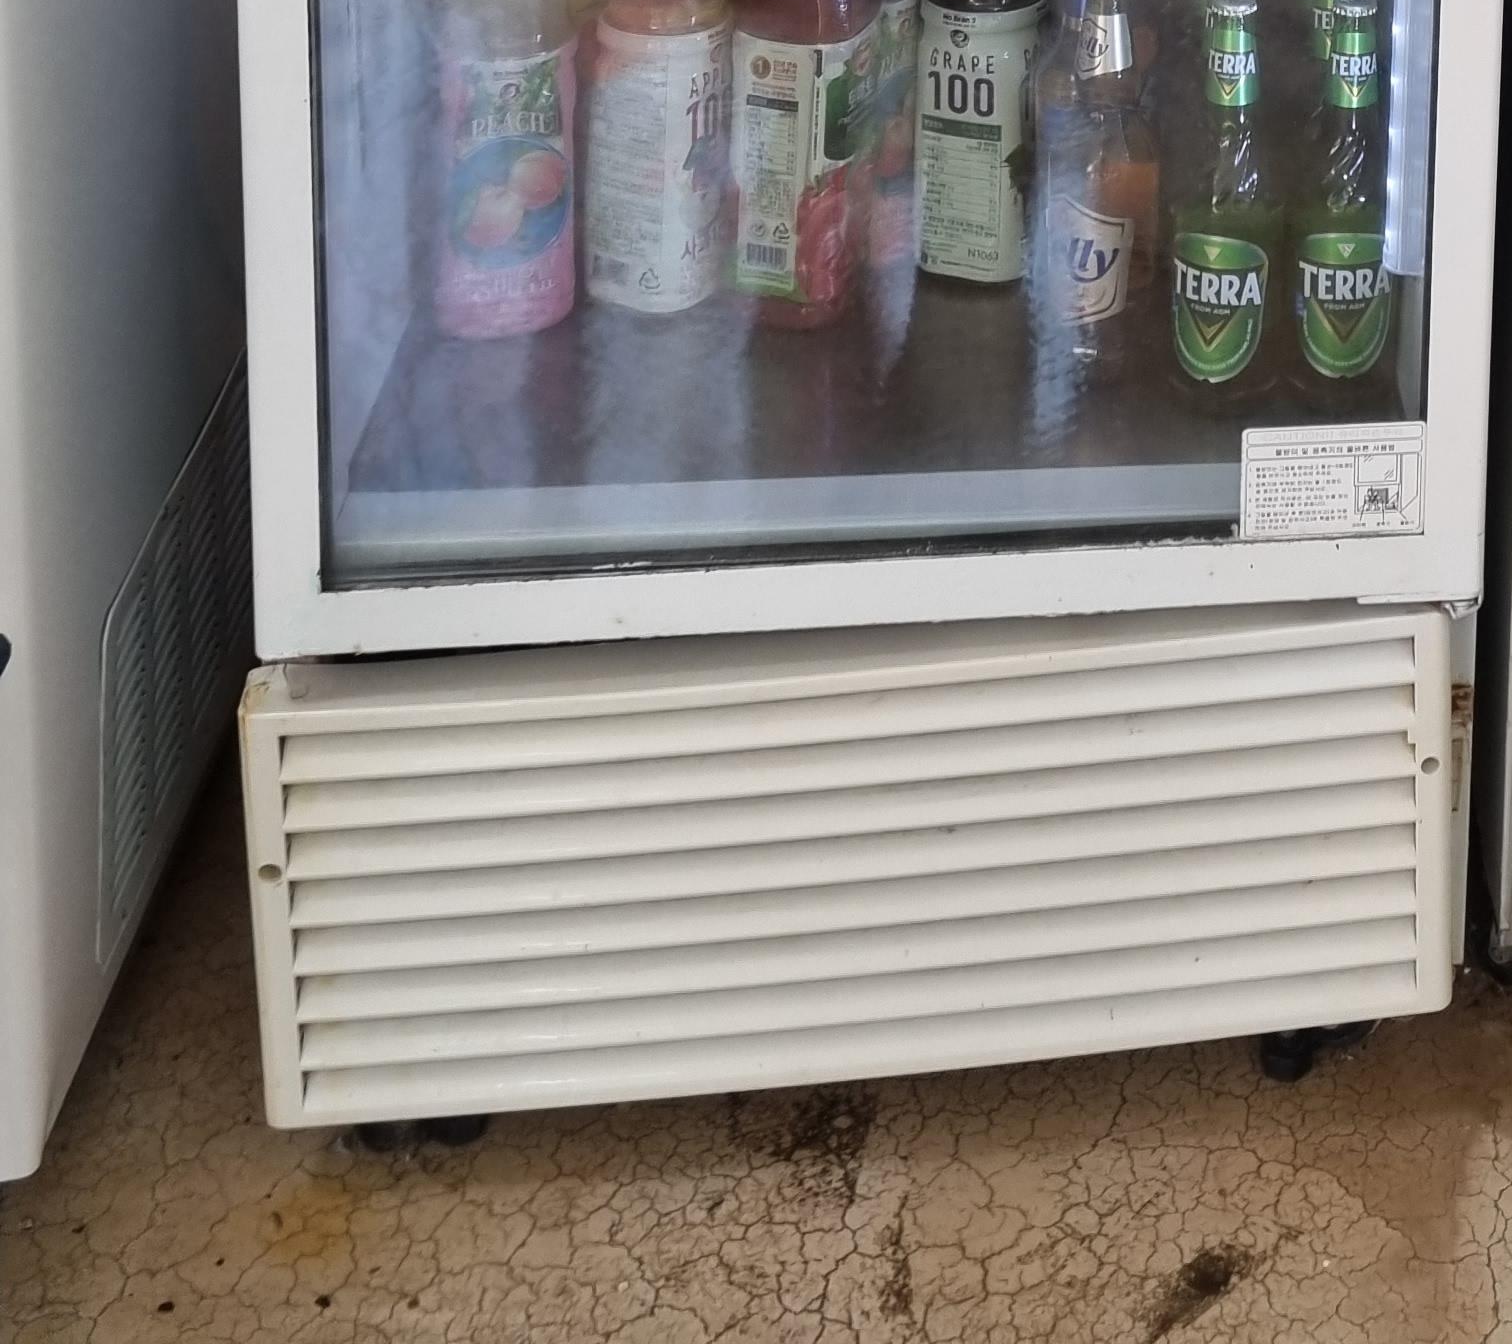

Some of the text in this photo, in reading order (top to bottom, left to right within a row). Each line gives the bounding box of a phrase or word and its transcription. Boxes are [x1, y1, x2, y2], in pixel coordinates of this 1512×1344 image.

[929, 47, 995, 75] GRAPE
[1208, 48, 1257, 76] TERRA
[1330, 52, 1378, 77] TERRA
[927, 70, 995, 118] 100
[1173, 256, 1262, 307] TERRA
[1298, 259, 1393, 301] TERRA
